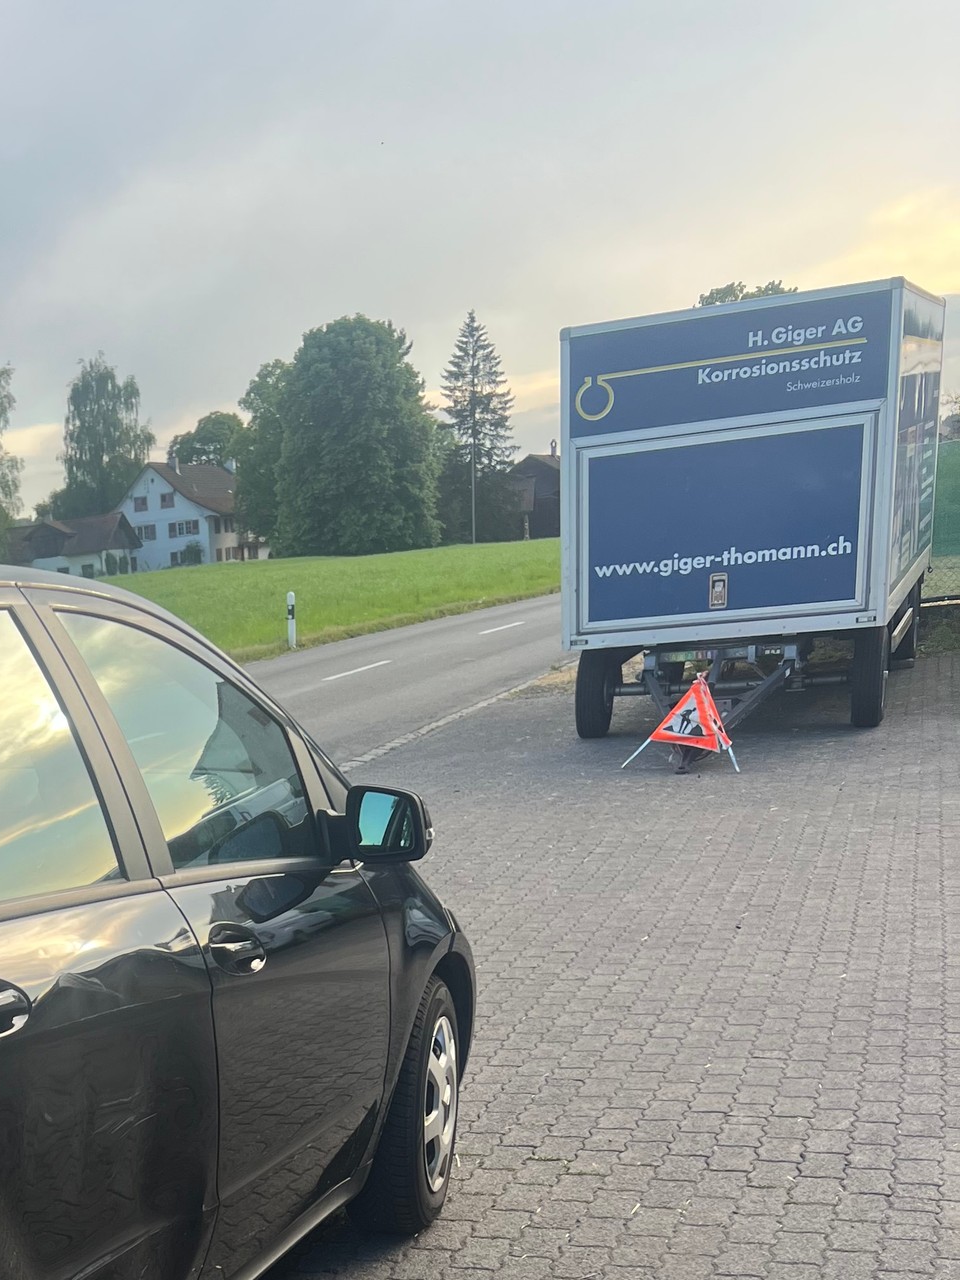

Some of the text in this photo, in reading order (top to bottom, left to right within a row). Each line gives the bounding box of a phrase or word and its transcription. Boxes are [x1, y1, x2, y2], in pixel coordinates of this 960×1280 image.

[748, 316, 864, 347] H. Giger AG
[697, 350, 863, 385] Korrosionsschutz
[786, 372, 861, 392] Schweizersholz
[594, 535, 852, 578] www.giger-thomann.ch
